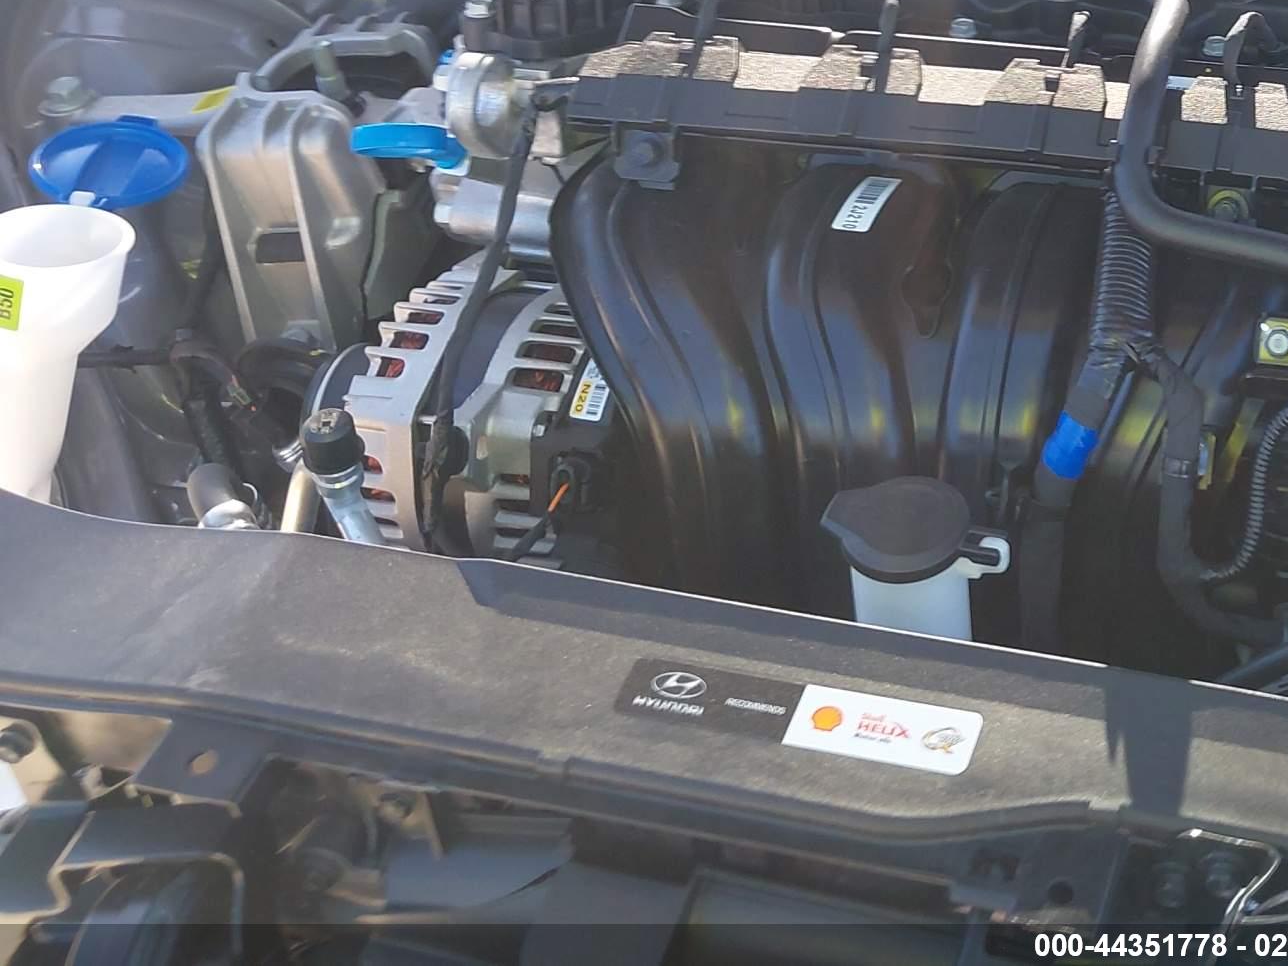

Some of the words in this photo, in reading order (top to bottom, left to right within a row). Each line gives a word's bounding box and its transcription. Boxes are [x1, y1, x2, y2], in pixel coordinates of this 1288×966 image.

[841, 205, 868, 229] 2J210
[575, 383, 592, 413] N20
[632, 695, 705, 715] HYUNDAI
[724, 697, 787, 715] RECOMMENDS
[857, 720, 910, 740] HELIX
